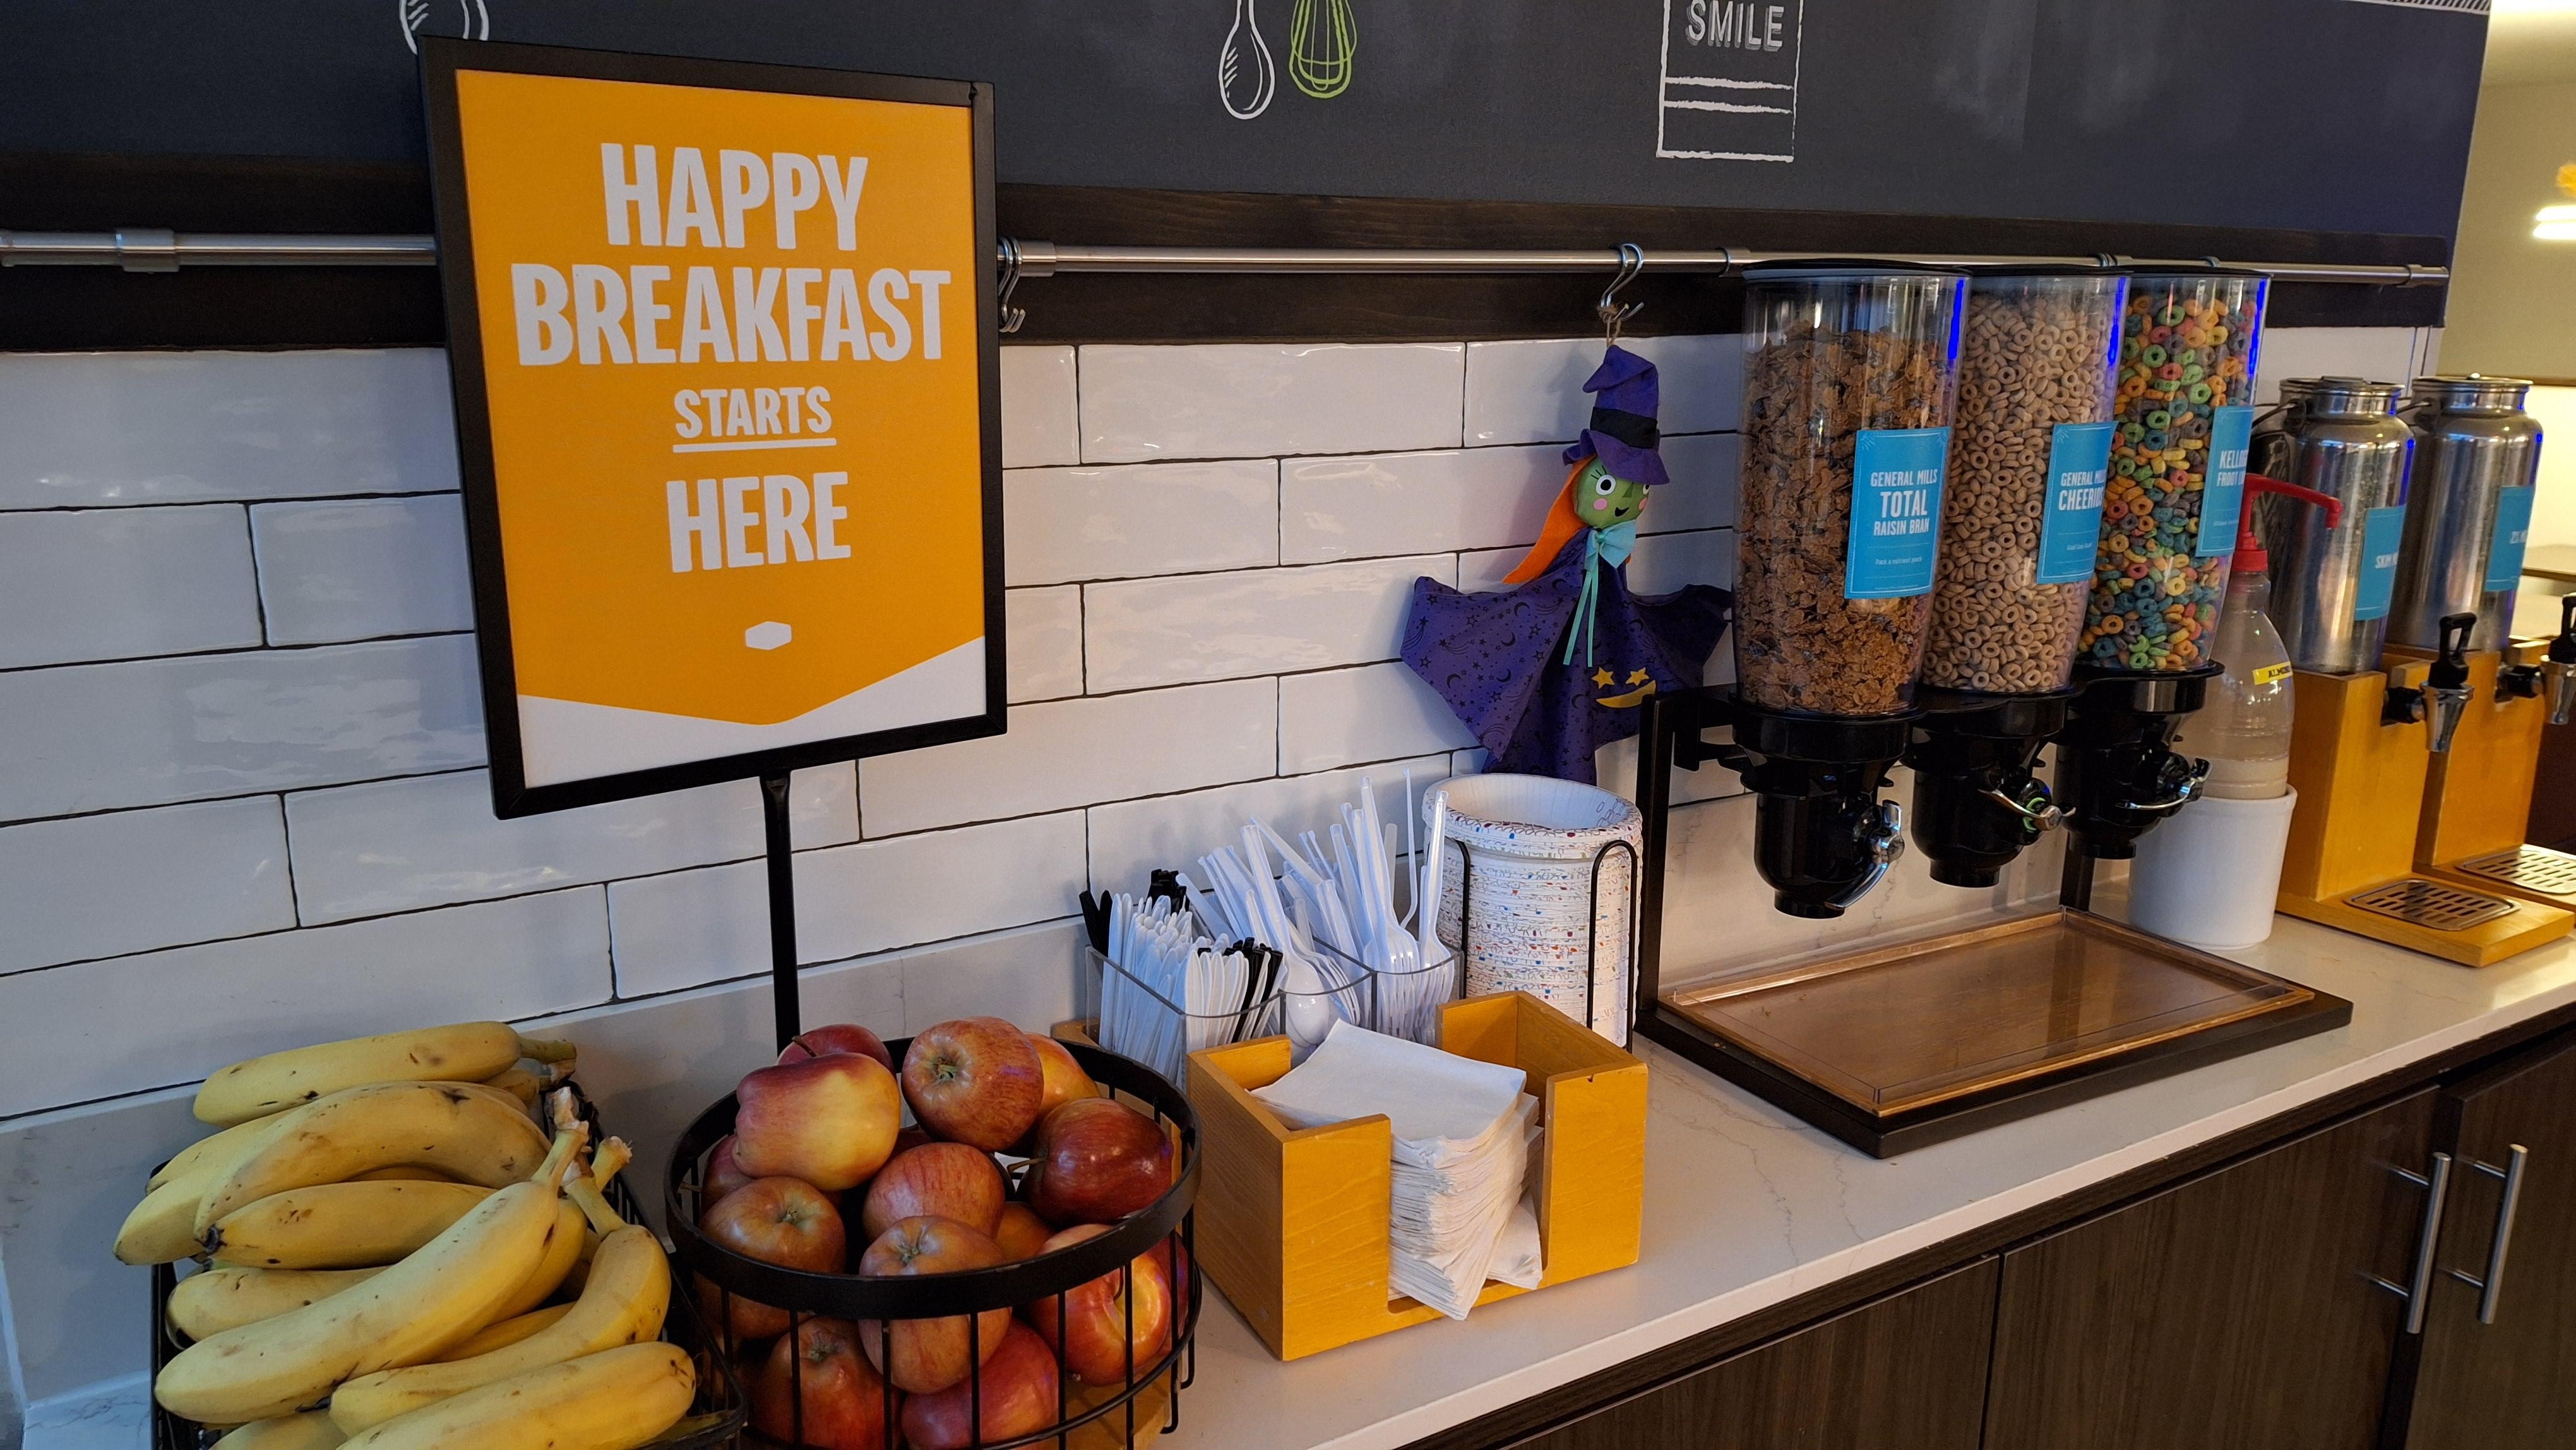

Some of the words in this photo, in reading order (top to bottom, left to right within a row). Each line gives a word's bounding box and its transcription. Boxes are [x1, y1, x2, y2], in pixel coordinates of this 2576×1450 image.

[1685, 0, 1784, 52] SMILE
[601, 143, 868, 251] HAPPY
[511, 264, 951, 366] BREAKFAST
[674, 386, 833, 438] STARTS
[1870, 470, 1914, 488] GENERAL
[1917, 469, 1938, 485] MILLS
[2061, 471, 2094, 487] GENERAL
[2217, 471, 2238, 487] FROOT
[1880, 489, 1928, 518] TOTAL
[666, 472, 851, 573] HERE
[1873, 520, 1907, 536] RAISIN
[1909, 518, 1929, 534] BRAN
[2269, 666, 2291, 678] ALMO
